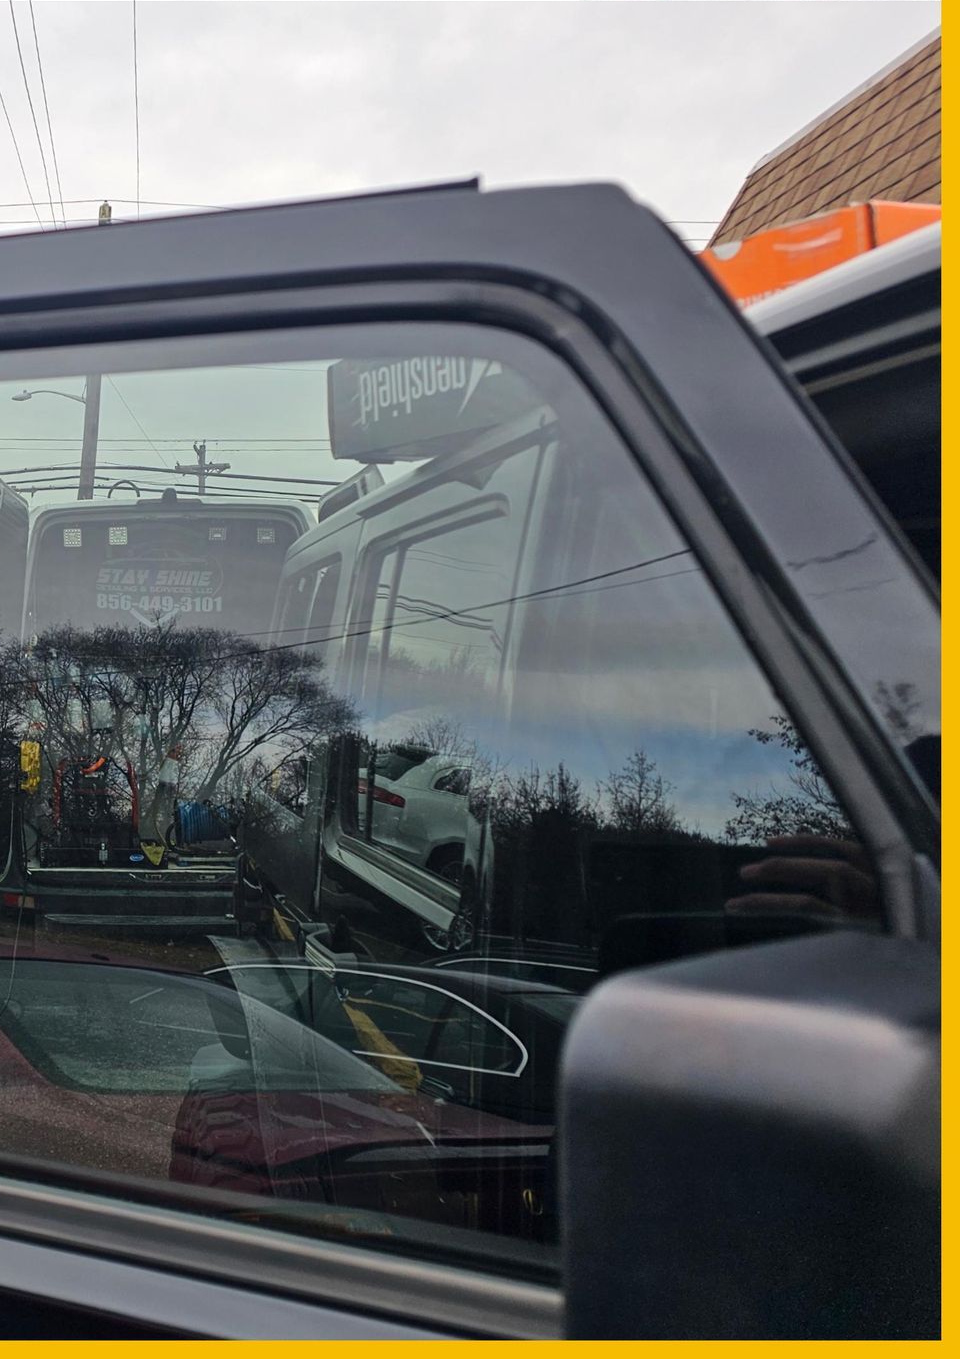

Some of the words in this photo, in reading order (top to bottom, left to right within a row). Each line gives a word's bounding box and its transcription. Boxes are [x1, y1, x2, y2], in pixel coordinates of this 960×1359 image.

[96, 568, 150, 584] STAY
[155, 570, 213, 586] SHINE
[96, 593, 223, 613] 856-449-3101
